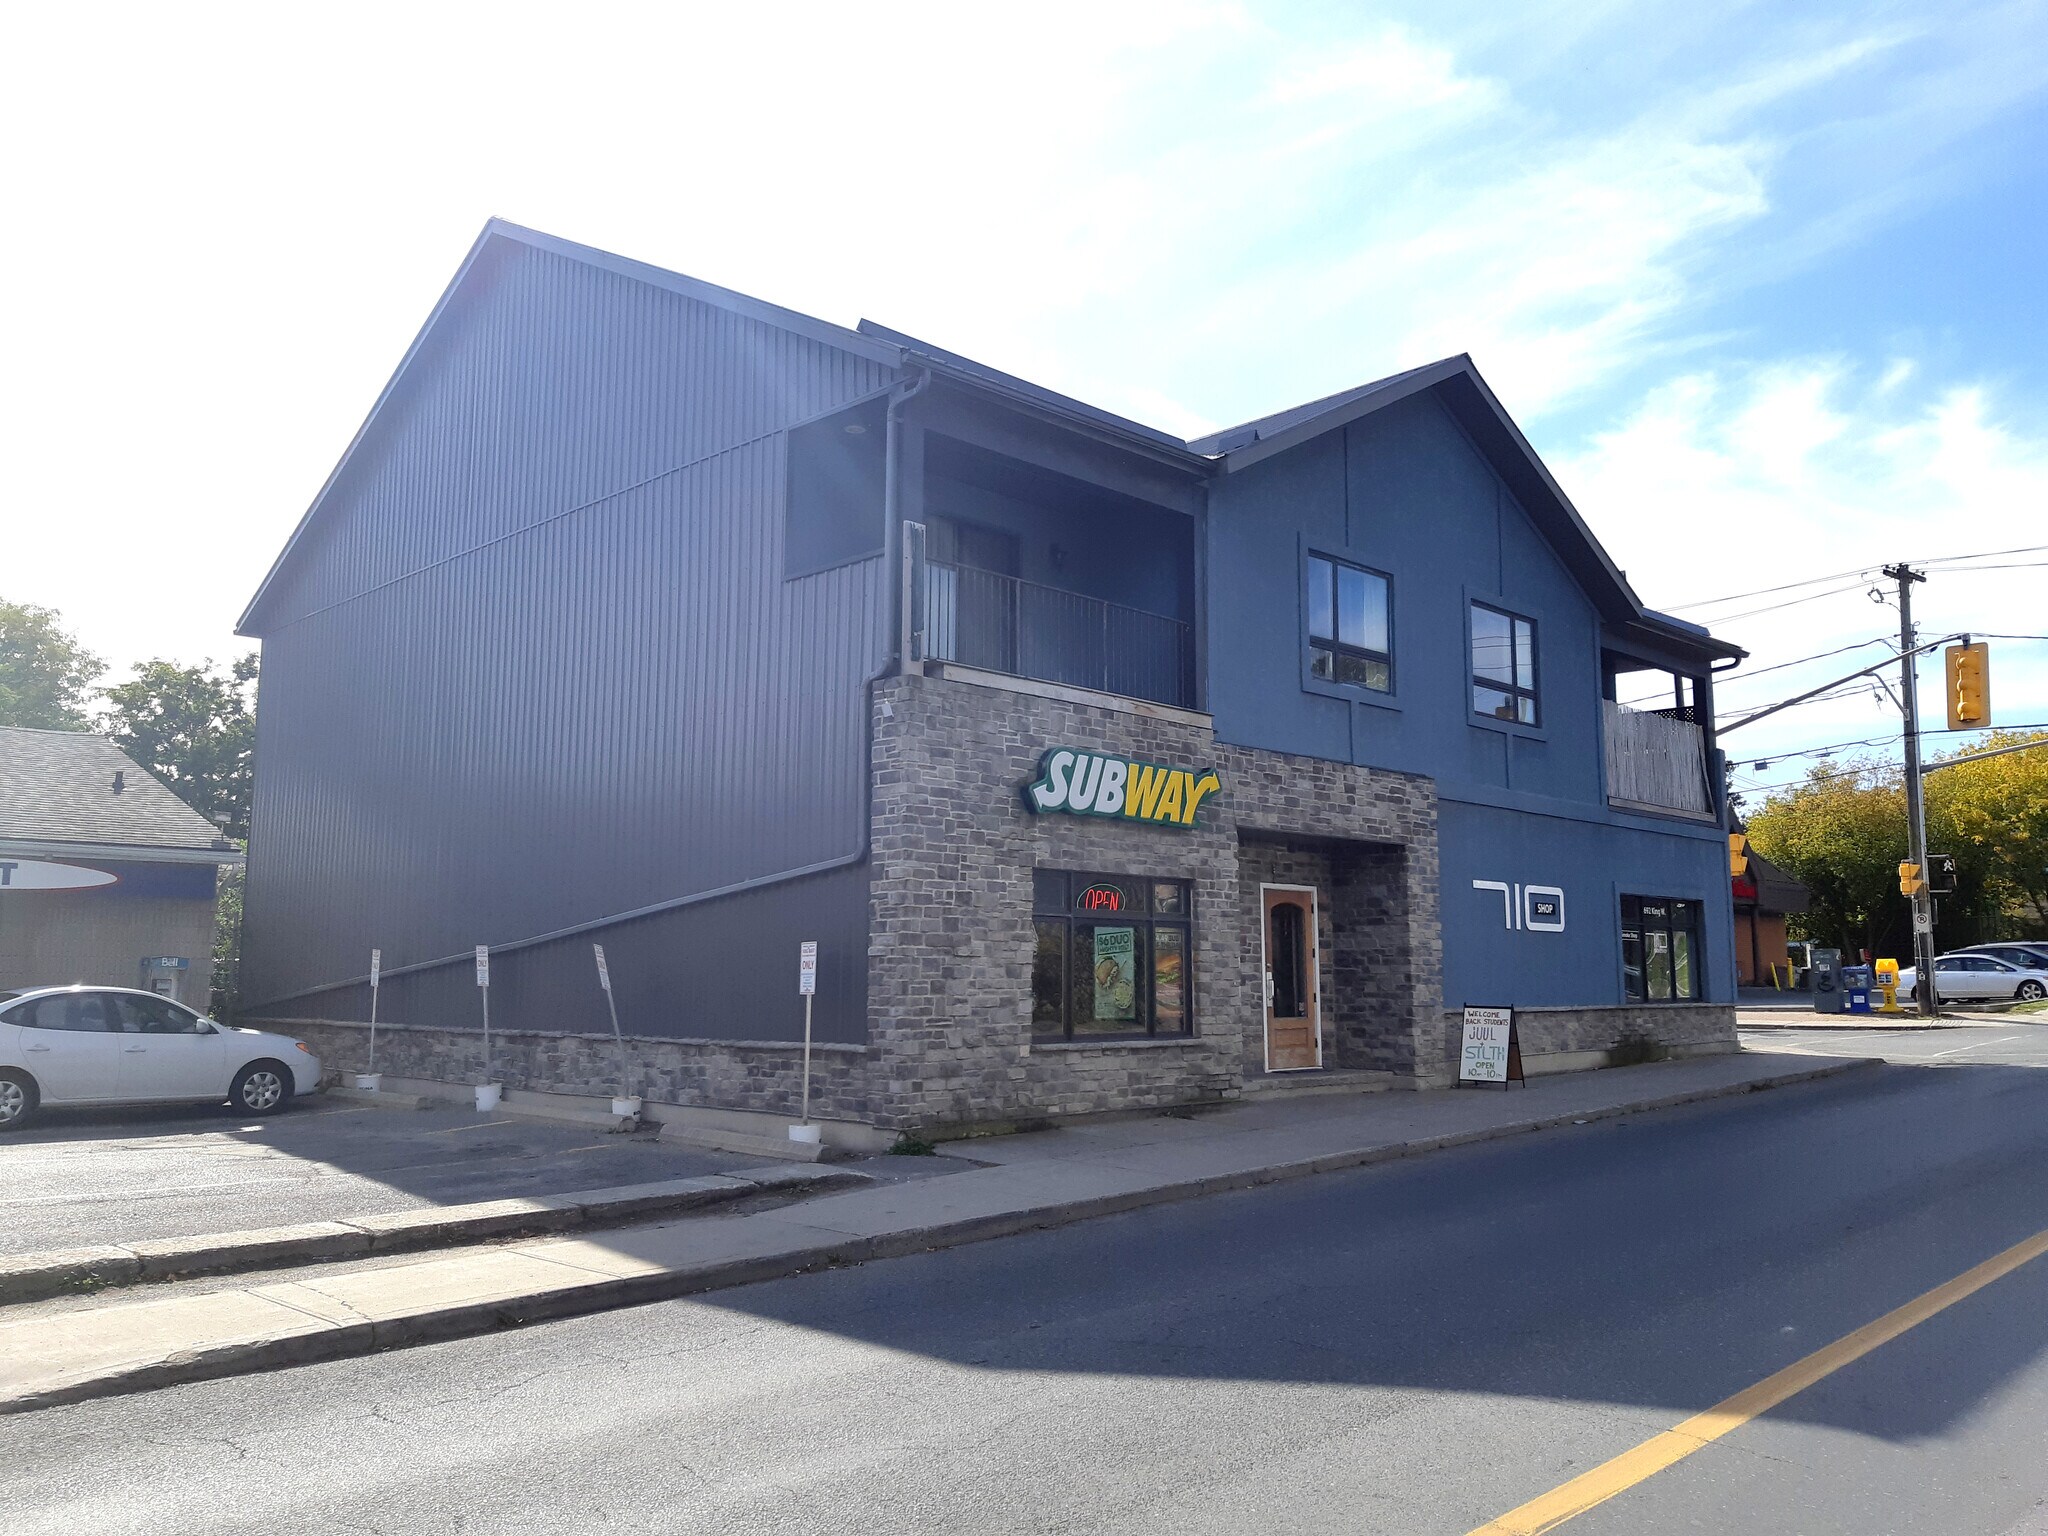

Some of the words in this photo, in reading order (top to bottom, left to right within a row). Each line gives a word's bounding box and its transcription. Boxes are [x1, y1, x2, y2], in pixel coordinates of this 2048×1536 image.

[1033, 751, 1220, 825] SUBWAY
[1085, 889, 1119, 911] OPEN
[1472, 880, 1565, 932] 710
[1537, 903, 1554, 914] SHOP
[1110, 934, 1130, 945] DUO
[161, 957, 178, 966] Bell
[802, 960, 814, 970] ONLY
[1484, 1018, 1509, 1026] STUDENTS
[1465, 1046, 1505, 1061] STLTH
